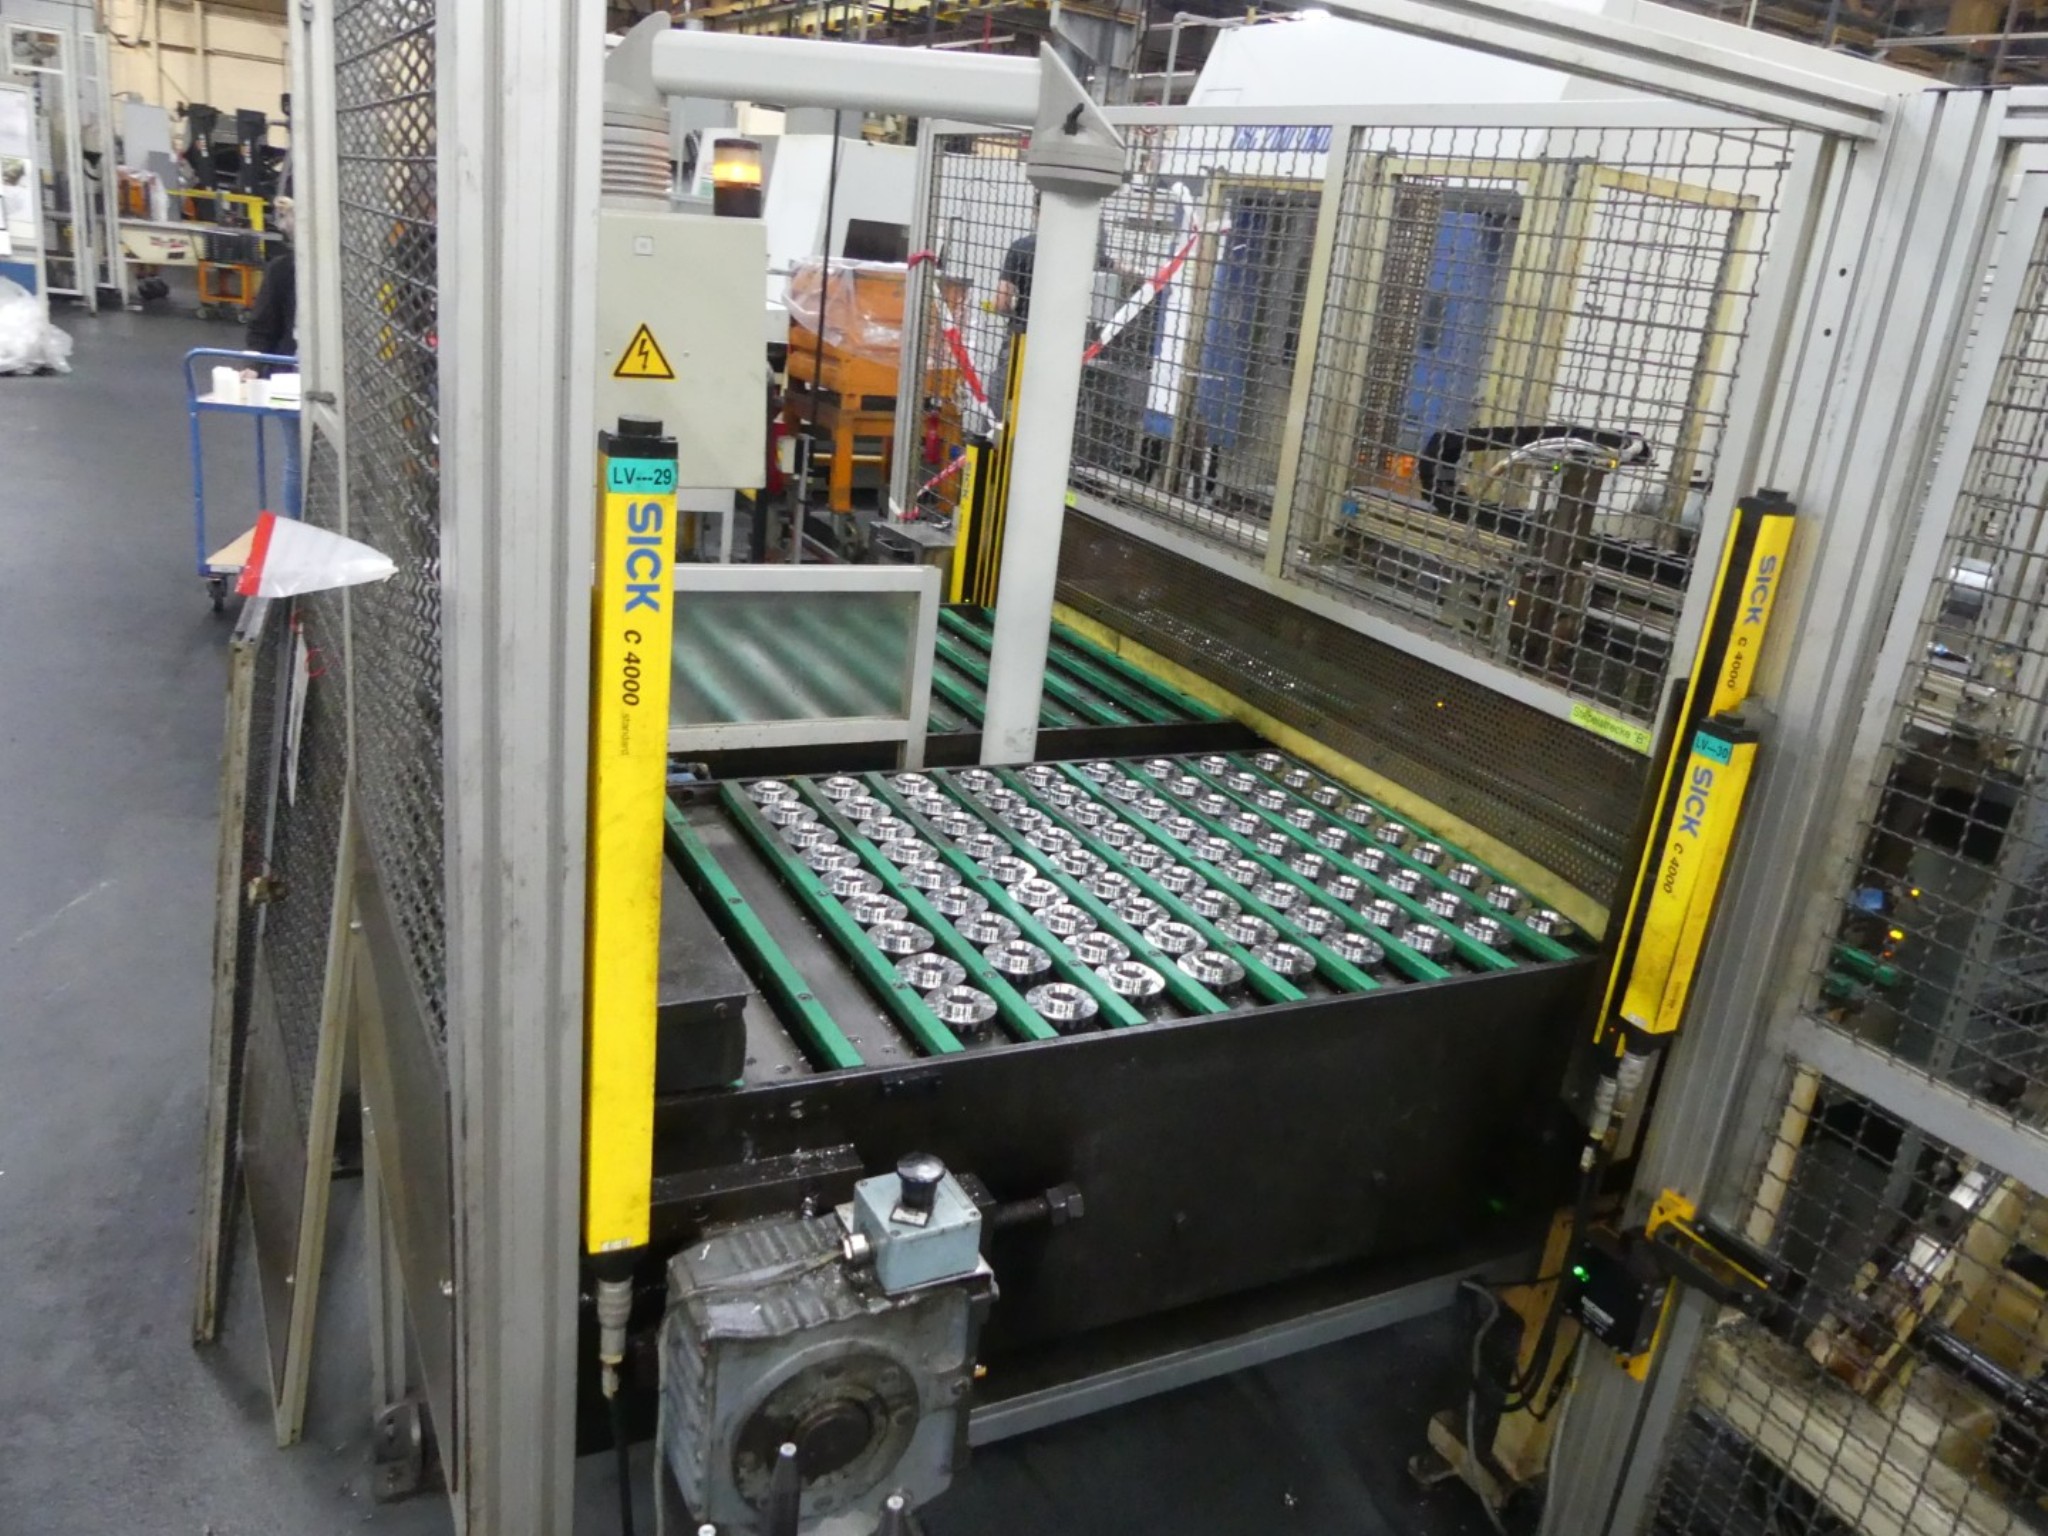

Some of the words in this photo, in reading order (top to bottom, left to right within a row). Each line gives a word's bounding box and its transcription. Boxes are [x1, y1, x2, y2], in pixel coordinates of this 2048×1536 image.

[625, 502, 664, 612] SICK
[1743, 555, 1777, 625] SICK
[623, 629, 642, 645] C
[622, 652, 641, 706] 4000
[1727, 651, 1743, 689] 4000
[1679, 765, 1713, 838] SICK
[1673, 843, 1684, 855] C
[1663, 856, 1681, 894] 4000
